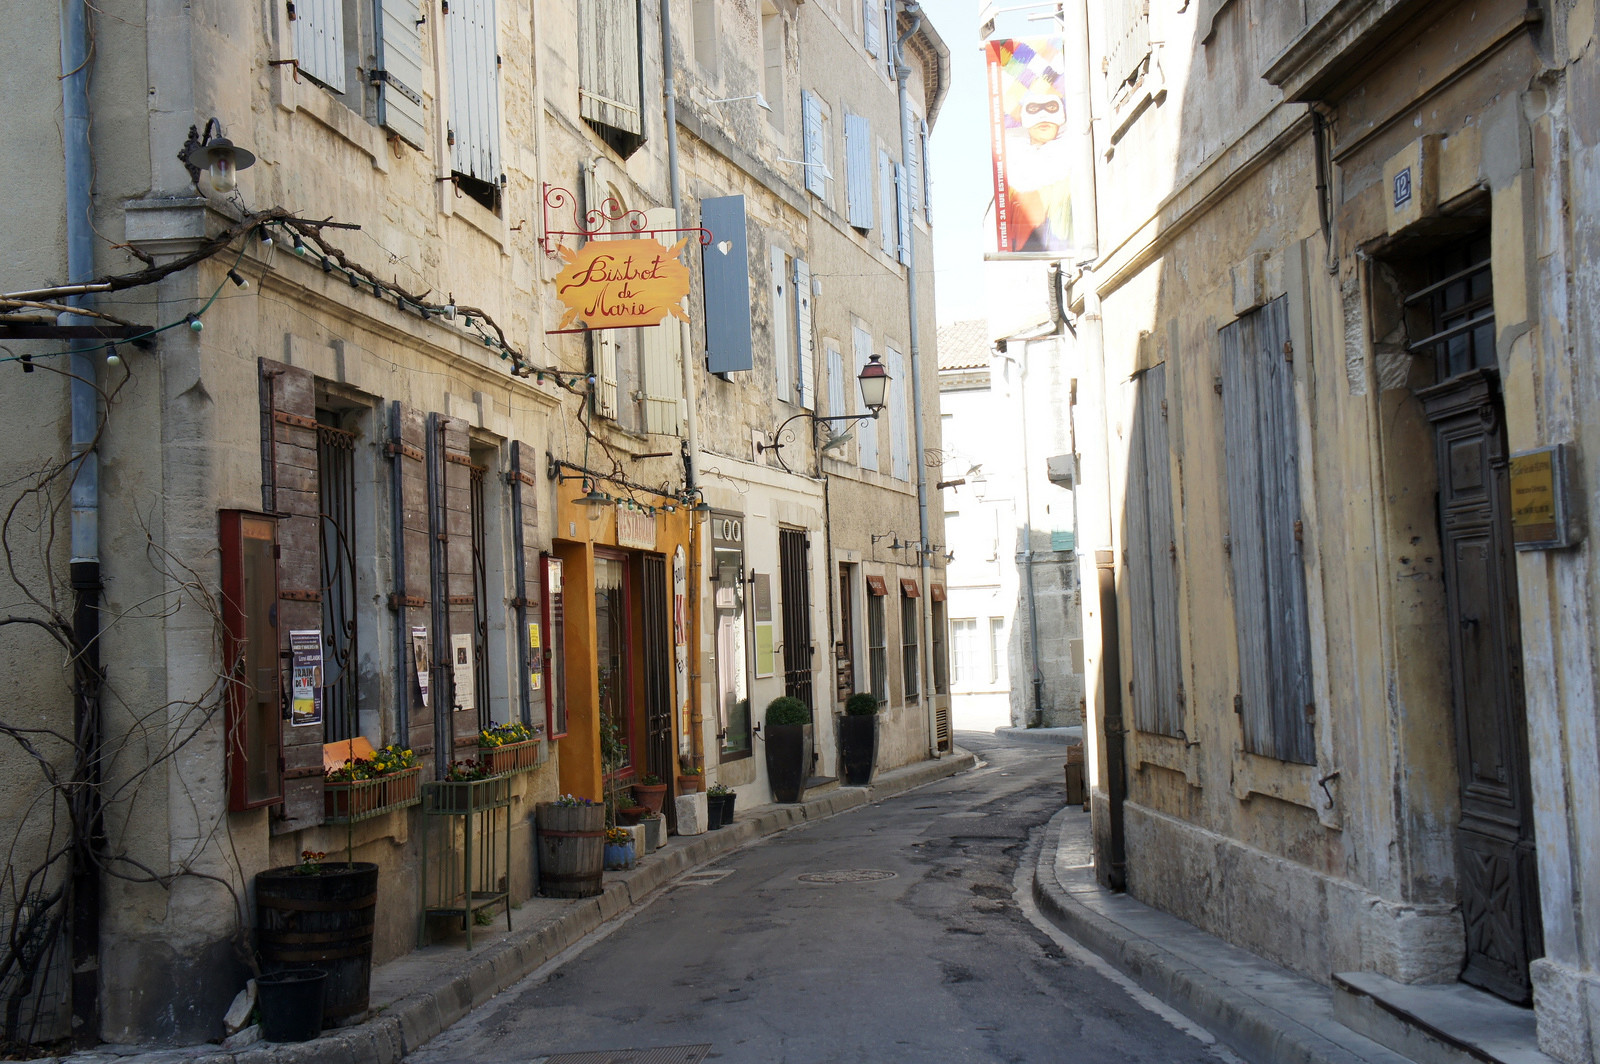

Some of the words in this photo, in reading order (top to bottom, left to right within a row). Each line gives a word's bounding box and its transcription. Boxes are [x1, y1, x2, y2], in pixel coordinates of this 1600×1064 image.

[1397, 176, 1406, 198] 12
[998, 193, 1006, 208] RUE
[560, 255, 668, 294] Bistrot
[584, 283, 662, 317] Marie
[617, 282, 646, 299] de
